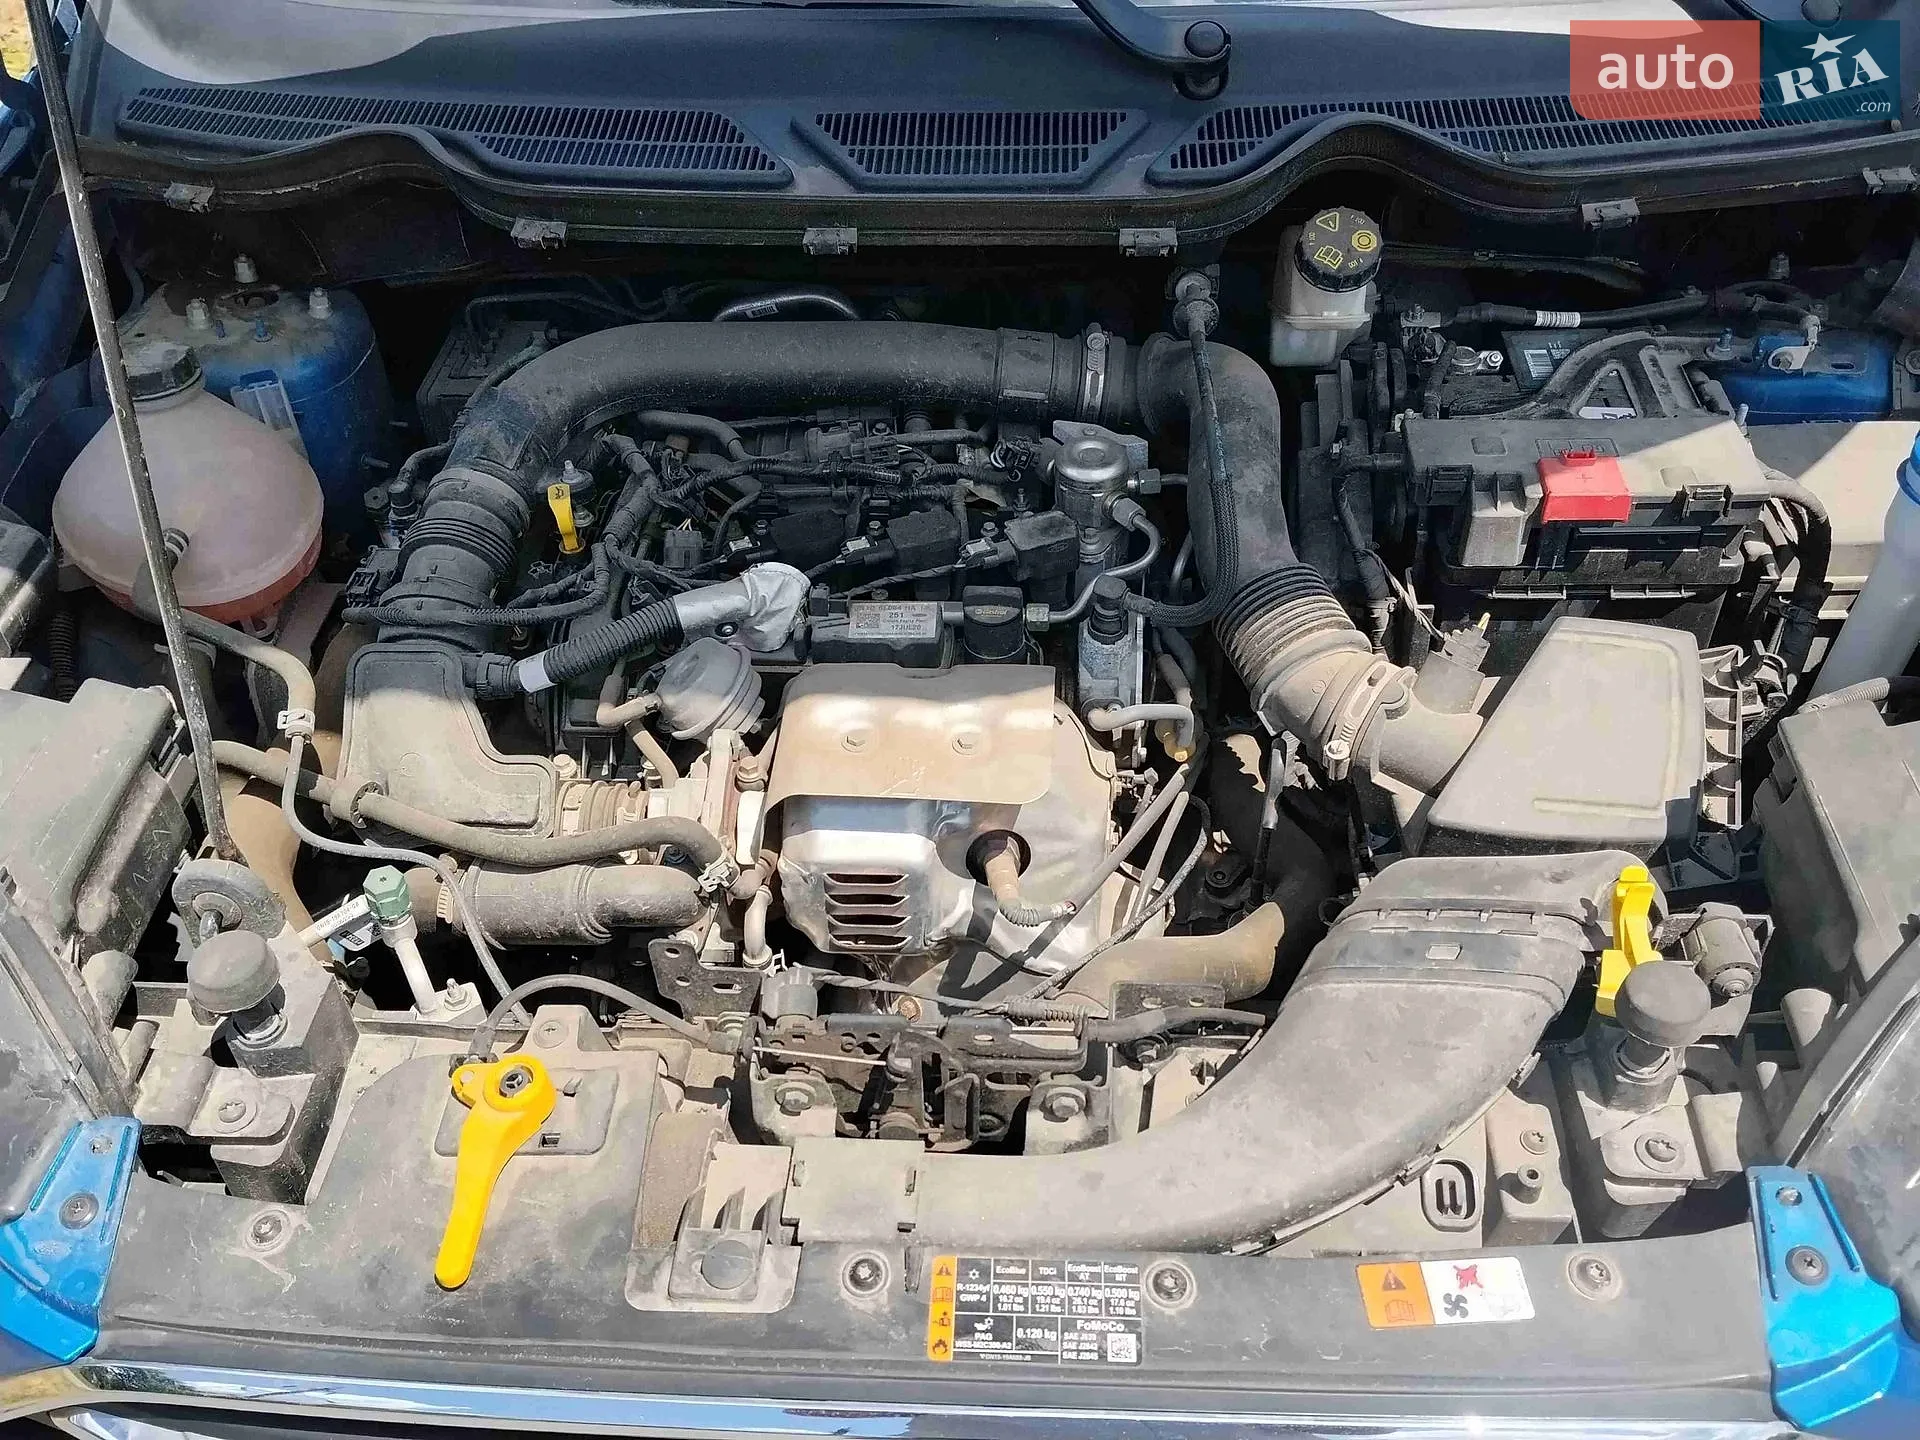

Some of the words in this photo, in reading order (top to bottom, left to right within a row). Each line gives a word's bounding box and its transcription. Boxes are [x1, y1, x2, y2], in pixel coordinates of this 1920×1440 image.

[956, 1282, 990, 1293] R-1234yf
[1017, 1285, 1029, 1297] kg
[1054, 1286, 1066, 1298] kg
[1091, 1287, 1103, 1300] kg
[1128, 1289, 1140, 1301] kg
[1076, 1319, 1125, 1332] FoMoCo
[974, 1332, 993, 1341] PAG
[1016, 1327, 1043, 1339] 0.120
[1044, 1328, 1058, 1342] kg
